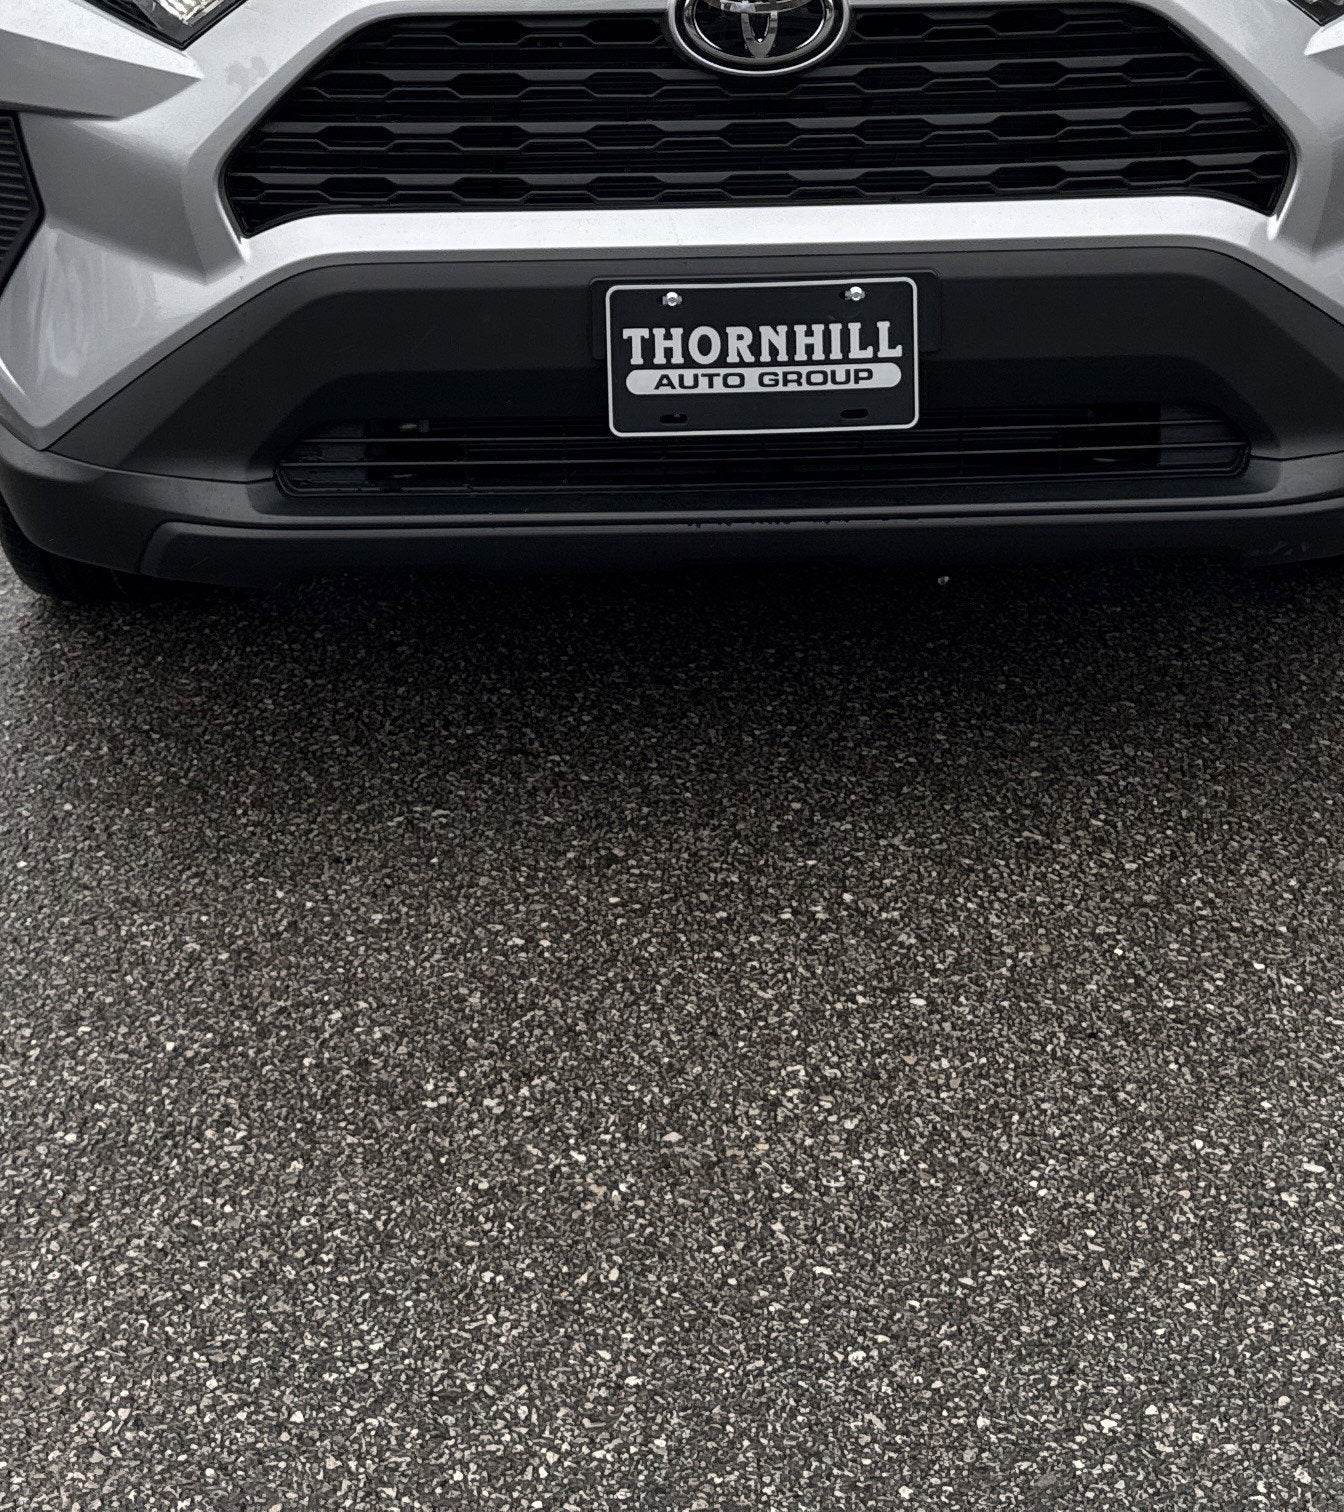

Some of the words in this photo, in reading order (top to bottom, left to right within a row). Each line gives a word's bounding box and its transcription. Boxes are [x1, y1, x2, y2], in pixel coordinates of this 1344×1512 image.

[622, 320, 903, 365] THORNHILL
[654, 371, 746, 390] AUTO
[757, 367, 875, 388] GROUP
